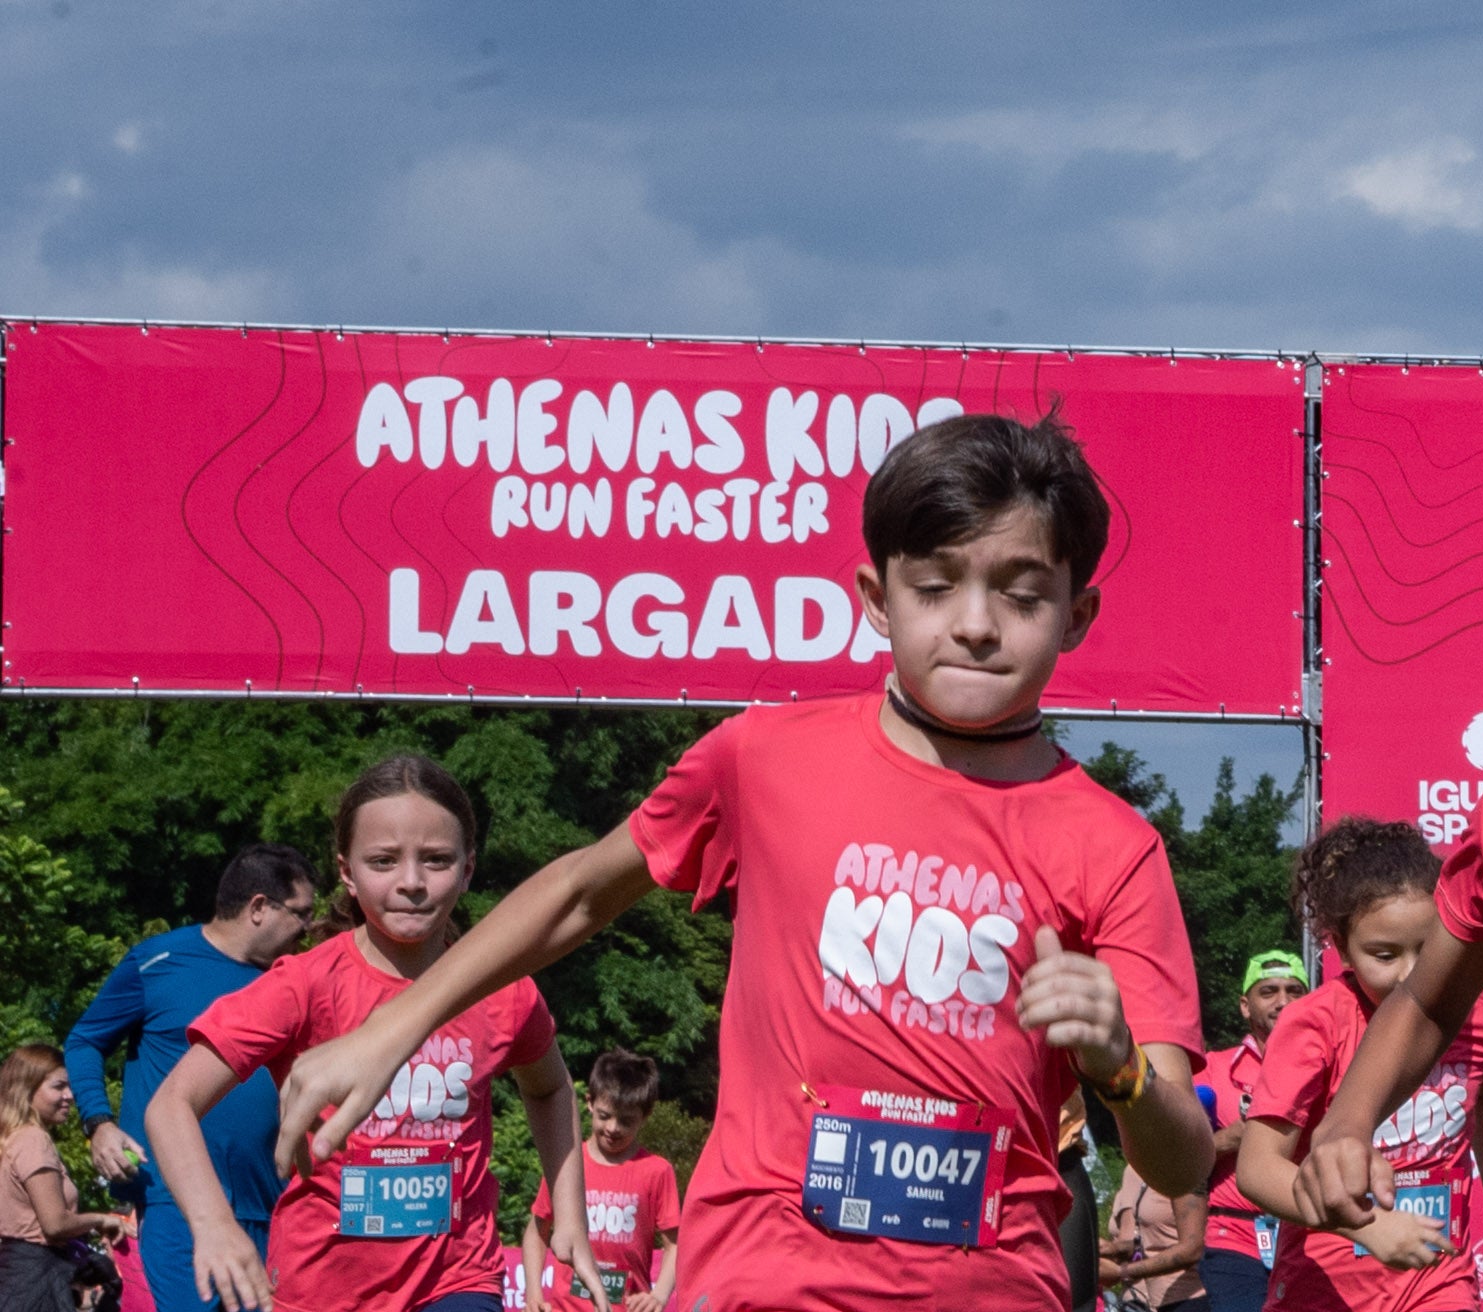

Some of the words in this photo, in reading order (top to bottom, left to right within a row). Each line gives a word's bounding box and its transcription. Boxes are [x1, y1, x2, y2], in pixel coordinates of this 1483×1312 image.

[356, 376, 744, 475] ATHENAS
[491, 476, 612, 539] RUN
[626, 477, 829, 543] FASTER
[389, 568, 893, 664] LARGAD
[834, 842, 1025, 924] ATHENAS
[818, 886, 1020, 1006] KIDS
[823, 976, 883, 1017] RUN
[890, 990, 996, 1042] FASTER
[375, 1061, 473, 1122] IDS
[861, 1090, 922, 1111] ATHENAS
[925, 1097, 958, 1117] KIDS
[814, 1117, 852, 1133] 250m
[869, 1139, 982, 1186] 10047
[379, 1175, 448, 1200] 10059
[808, 1173, 843, 1191] 2016
[906, 1185, 945, 1201] SAMUEL
[343, 1202, 365, 1212] 2017
[1399, 1195, 1445, 1217] 0071
[602, 1275, 624, 1288] 013
